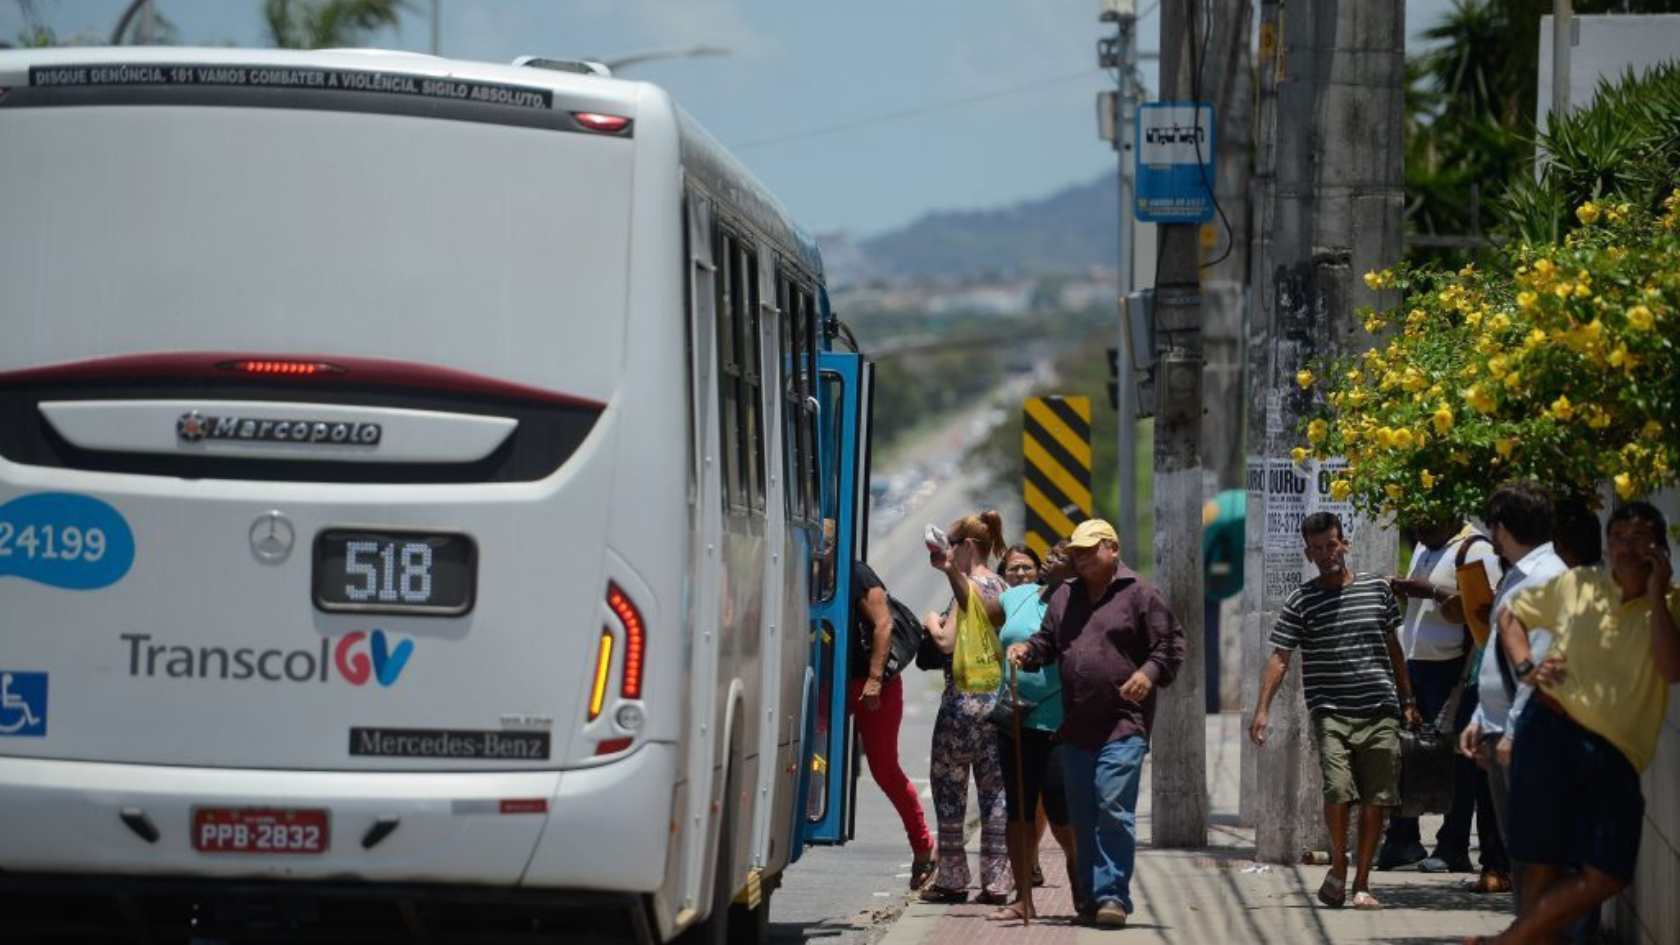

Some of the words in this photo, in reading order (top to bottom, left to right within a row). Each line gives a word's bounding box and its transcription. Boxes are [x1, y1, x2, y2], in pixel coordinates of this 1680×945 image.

[36, 69, 86, 85] DISQUE
[199, 69, 246, 84] VAMOS
[250, 70, 325, 87] COMBATER
[328, 72, 338, 86] A
[422, 79, 467, 98] SIGILO
[213, 416, 380, 444] Marcopolo
[0, 521, 106, 562] 24199
[345, 541, 433, 602] 518
[359, 729, 543, 758] Mercedes-Benz
